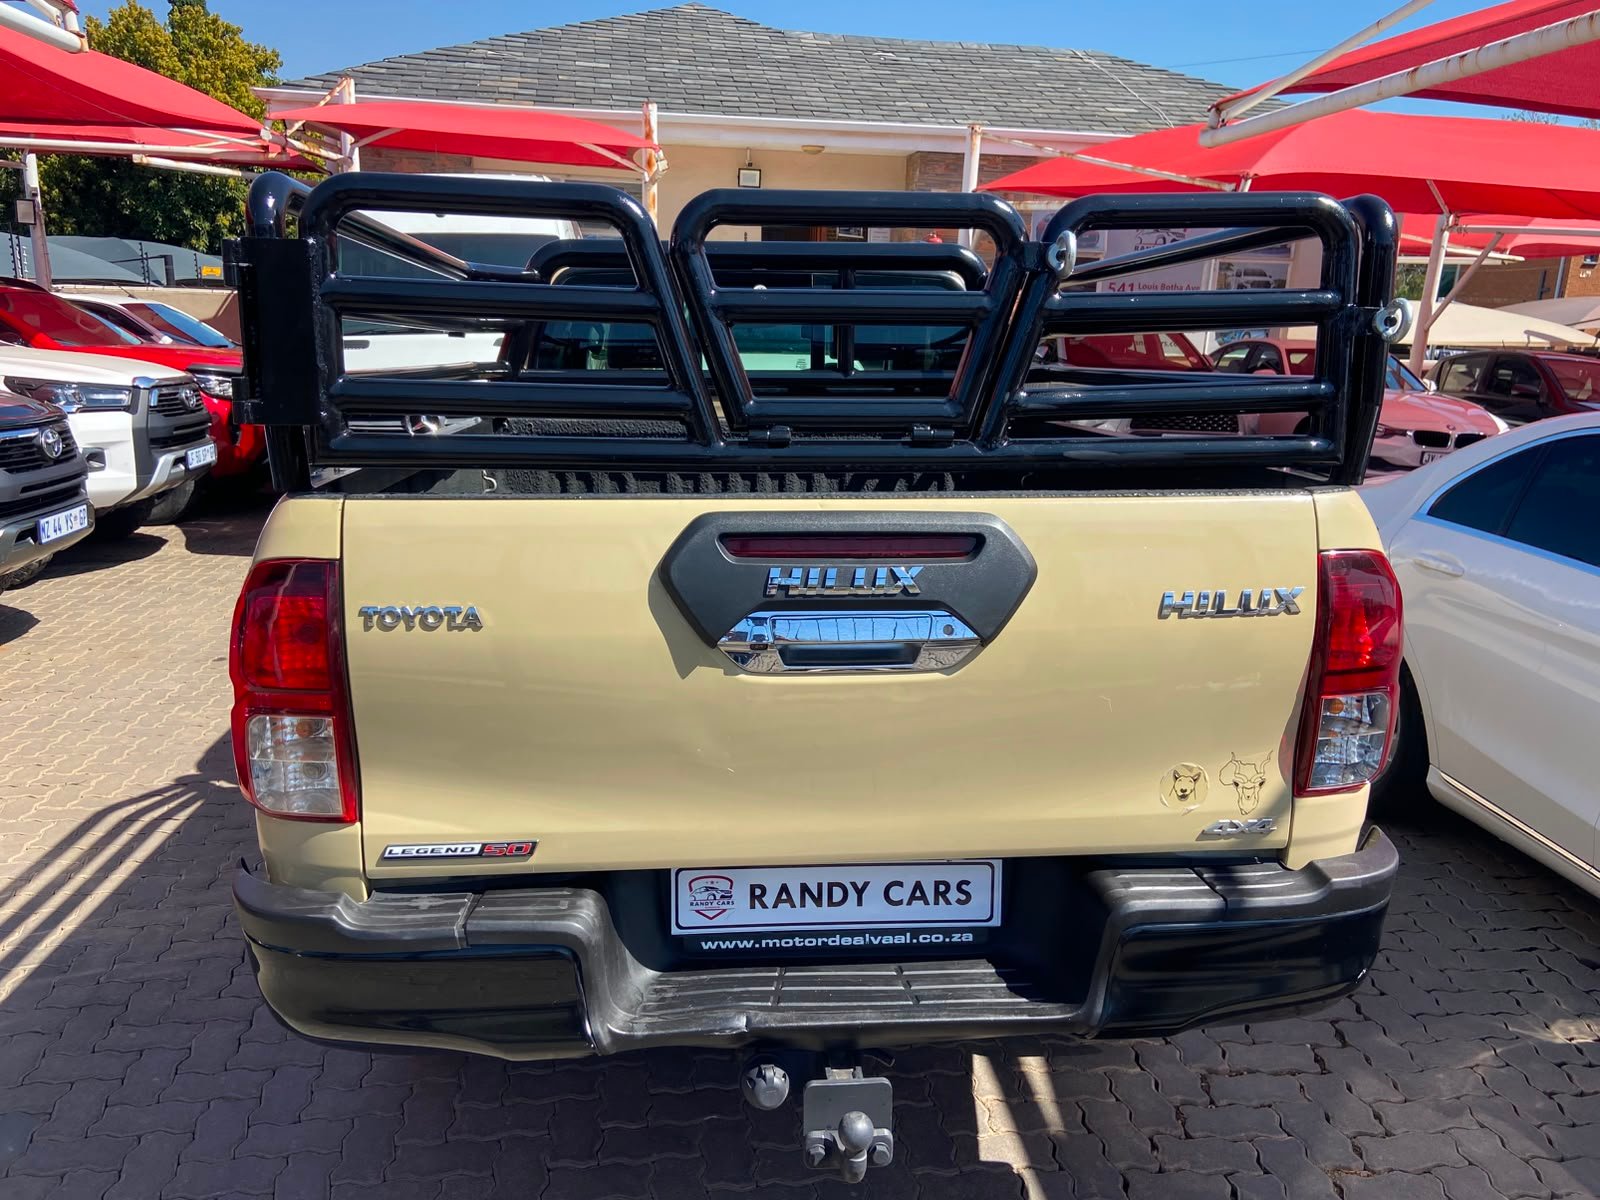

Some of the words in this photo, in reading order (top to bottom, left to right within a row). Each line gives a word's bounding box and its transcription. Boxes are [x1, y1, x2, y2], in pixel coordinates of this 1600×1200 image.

[1108, 283, 1134, 292] 541
[1160, 283, 1183, 291] Botha
[41, 520, 50, 540] NZ
[53, 516, 62, 536] 44
[765, 567, 924, 596] HILUX
[1160, 586, 1305, 617] HILUX
[358, 605, 483, 631] TOYOTA
[387, 846, 475, 857] LEGEND
[483, 842, 532, 857] 50
[749, 880, 871, 910] RANDY
[883, 879, 972, 906] CARS
[700, 932, 974, 950] www.motordealvaal.co.za
